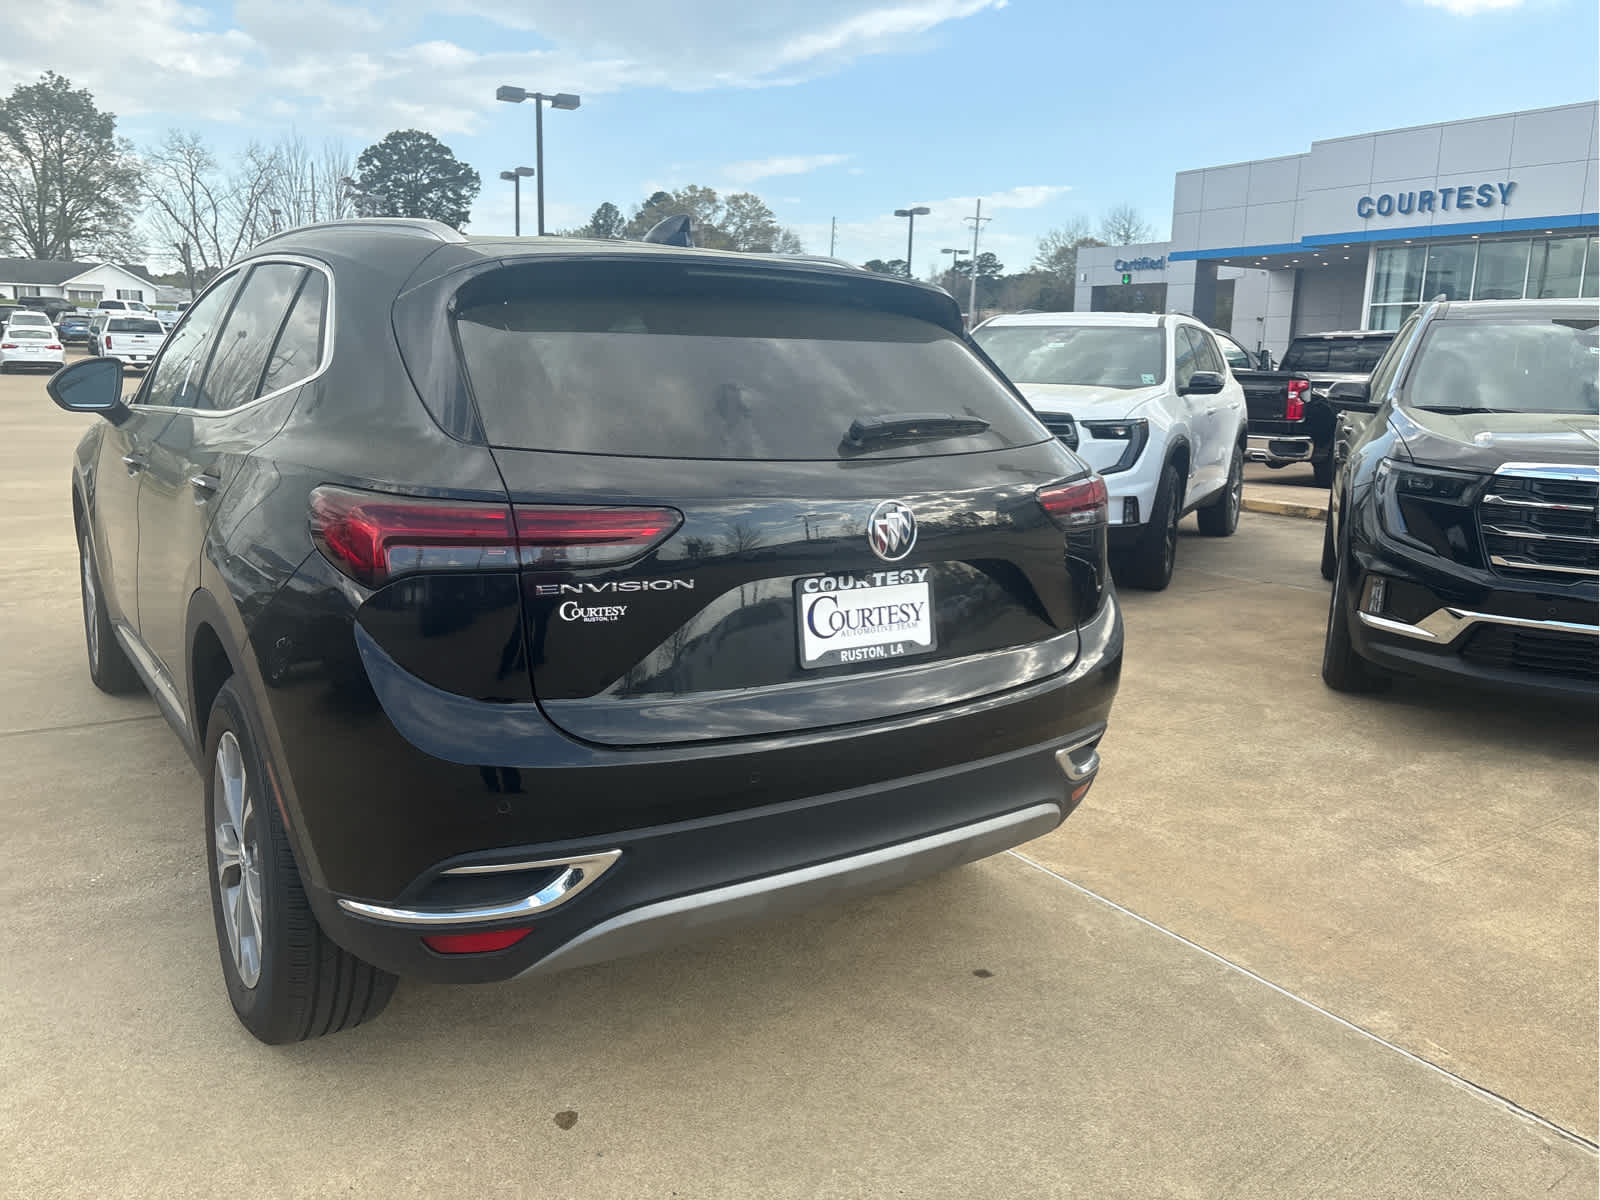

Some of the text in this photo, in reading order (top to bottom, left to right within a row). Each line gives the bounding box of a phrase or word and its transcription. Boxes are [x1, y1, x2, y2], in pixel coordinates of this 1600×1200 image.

[1357, 181, 1517, 218] COURTESY
[1114, 256, 1165, 272] Certified
[536, 579, 695, 595] ENVISION
[841, 621, 919, 638] AUTOMOTIVE TEAM
[840, 643, 904, 662] RUSTON, LA
